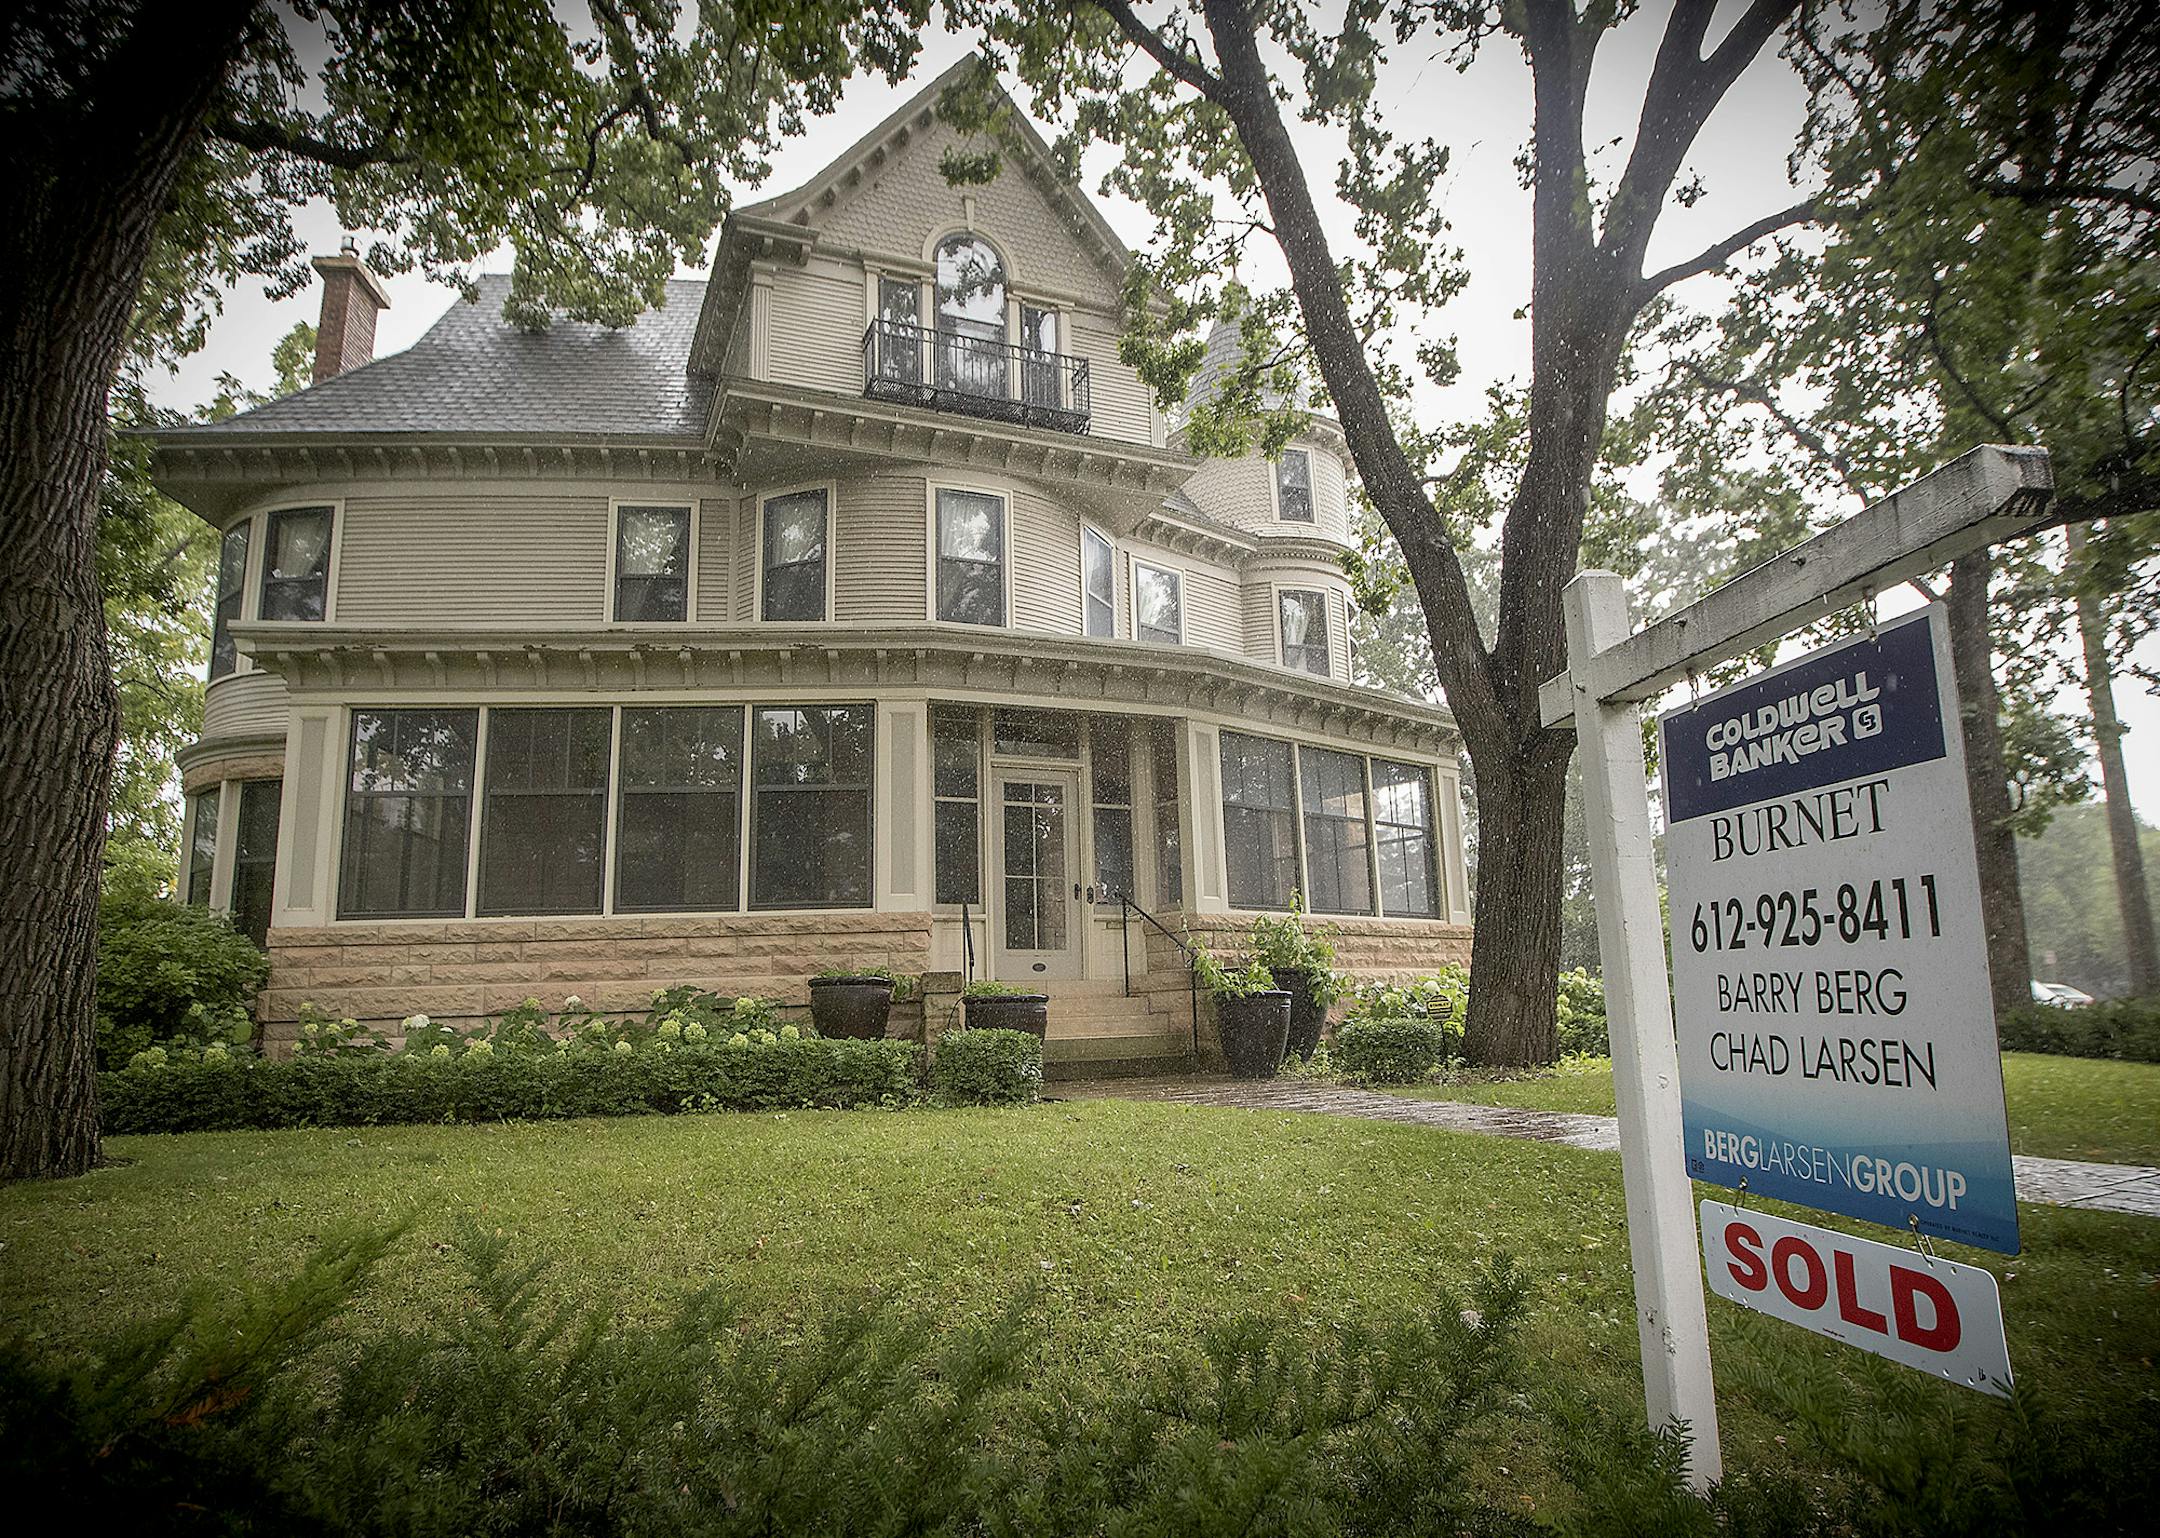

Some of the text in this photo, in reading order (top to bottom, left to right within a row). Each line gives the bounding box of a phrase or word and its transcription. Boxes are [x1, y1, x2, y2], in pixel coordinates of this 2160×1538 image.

[1710, 778, 1889, 862] BURNET
[1691, 874, 1941, 953] 612-925-8411
[1717, 968, 1907, 1016] BARRY BERG
[1710, 1032, 1937, 1092] CHAD LARSEN
[1704, 1128, 1967, 1211] BERGLARSENGROUP
[1724, 1222, 1962, 1353] SOLD
